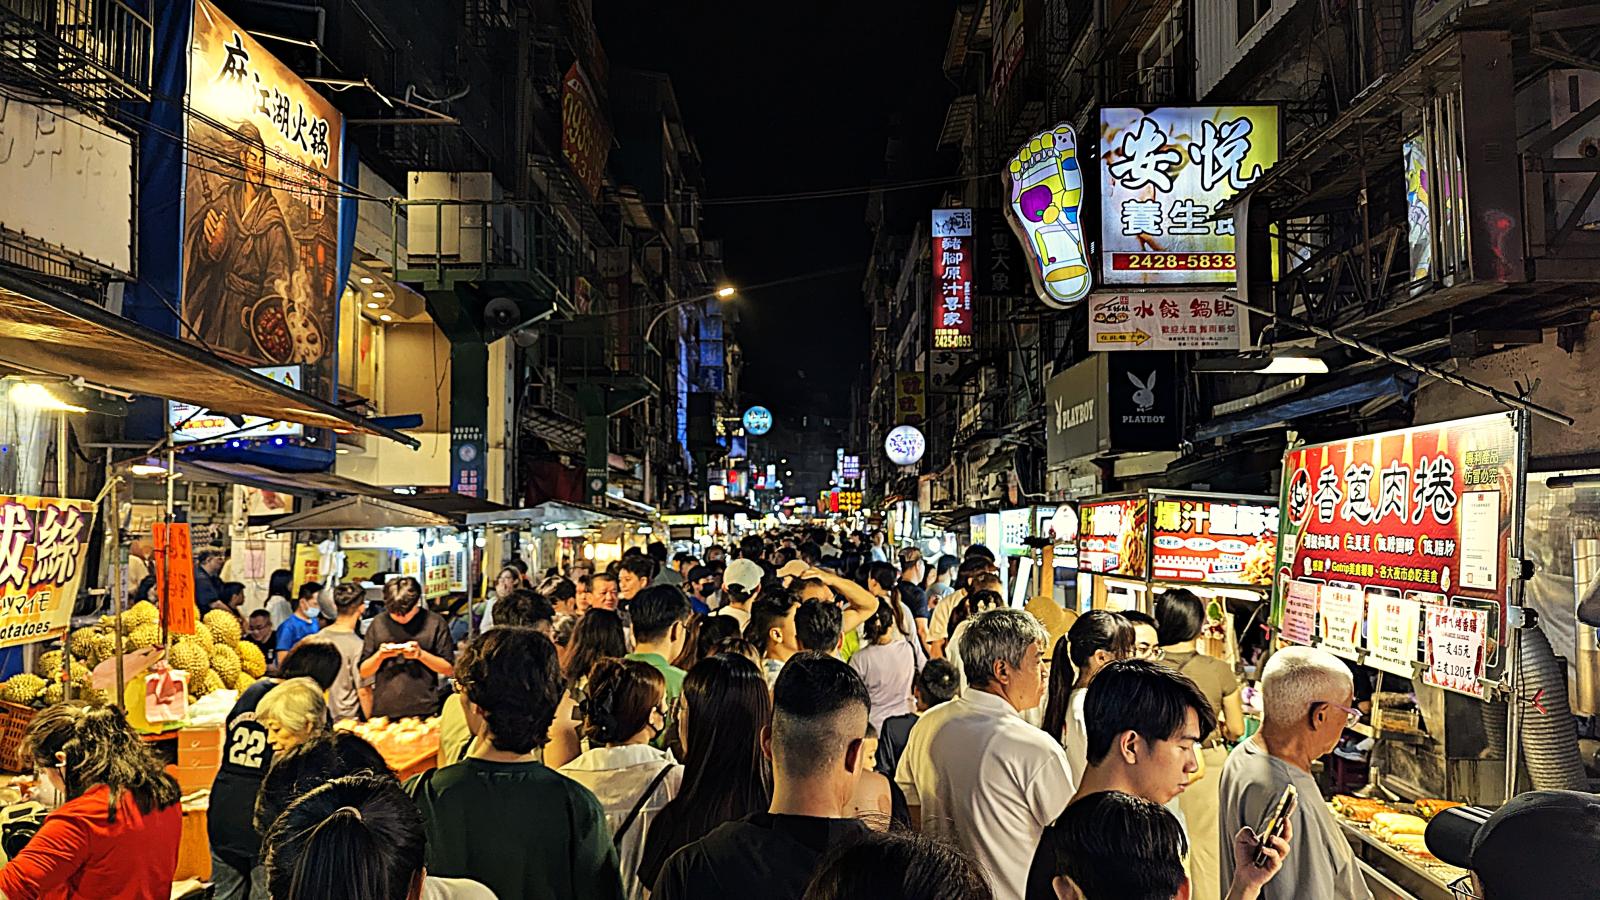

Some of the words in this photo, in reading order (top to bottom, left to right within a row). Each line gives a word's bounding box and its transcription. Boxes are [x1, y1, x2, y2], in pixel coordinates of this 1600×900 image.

[1129, 254, 1236, 269] 2428-5833
[1133, 298, 1180, 319] 水餃
[1189, 297, 1235, 319] 鍋貼
[1062, 399, 1095, 430] PLAYBOY
[1122, 415, 1166, 424] PLAYBOY
[1464, 467, 1498, 485] 仿冒必究
[1438, 641, 1471, 659] 一支45元
[1436, 661, 1473, 680] 三支120元
[229, 727, 266, 769] 22
